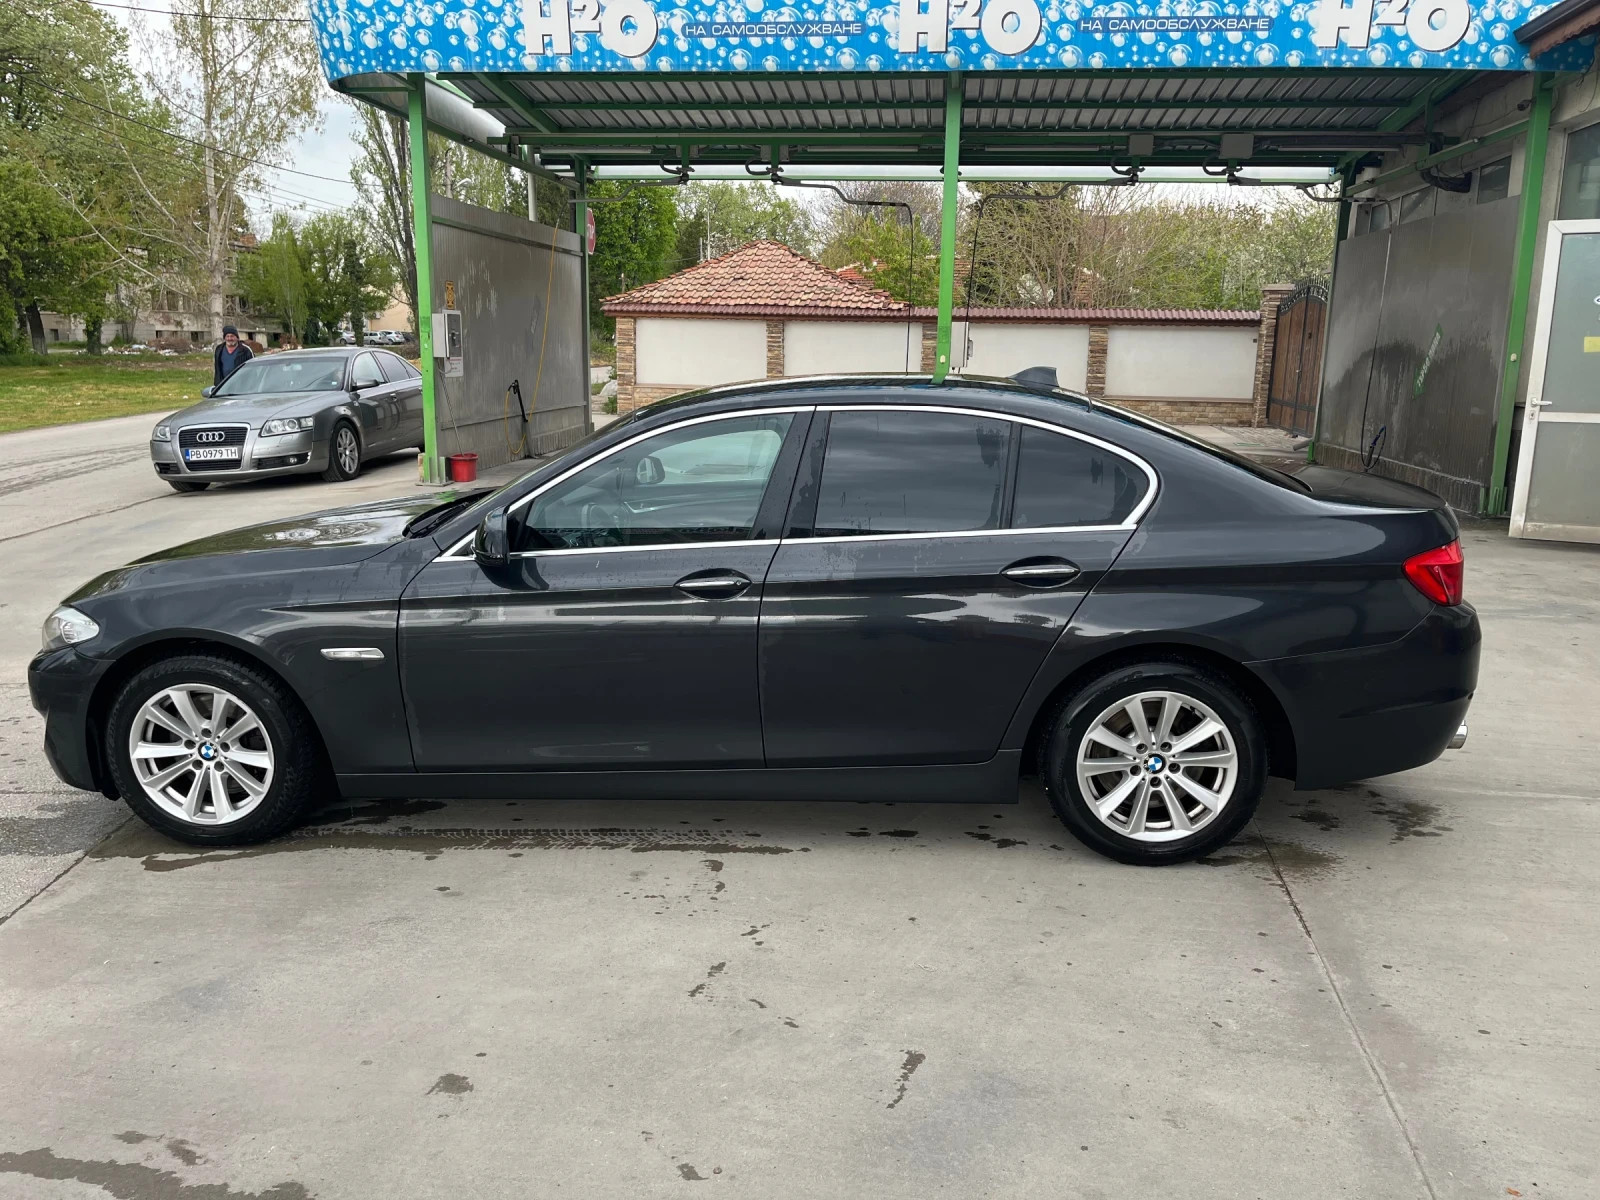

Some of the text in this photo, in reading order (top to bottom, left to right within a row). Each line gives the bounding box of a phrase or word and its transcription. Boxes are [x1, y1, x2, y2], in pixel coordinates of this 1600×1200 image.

[523, 0, 658, 58] H2O
[686, 23, 862, 36] НА САМООБСЛУЖВАНЕ
[899, 0, 1042, 56] H2O
[1080, 18, 1270, 31] НА САМООБСЛУЖВАНЕ
[1316, 0, 1470, 52] H2O
[190, 449, 236, 459] PB 0979 TH
